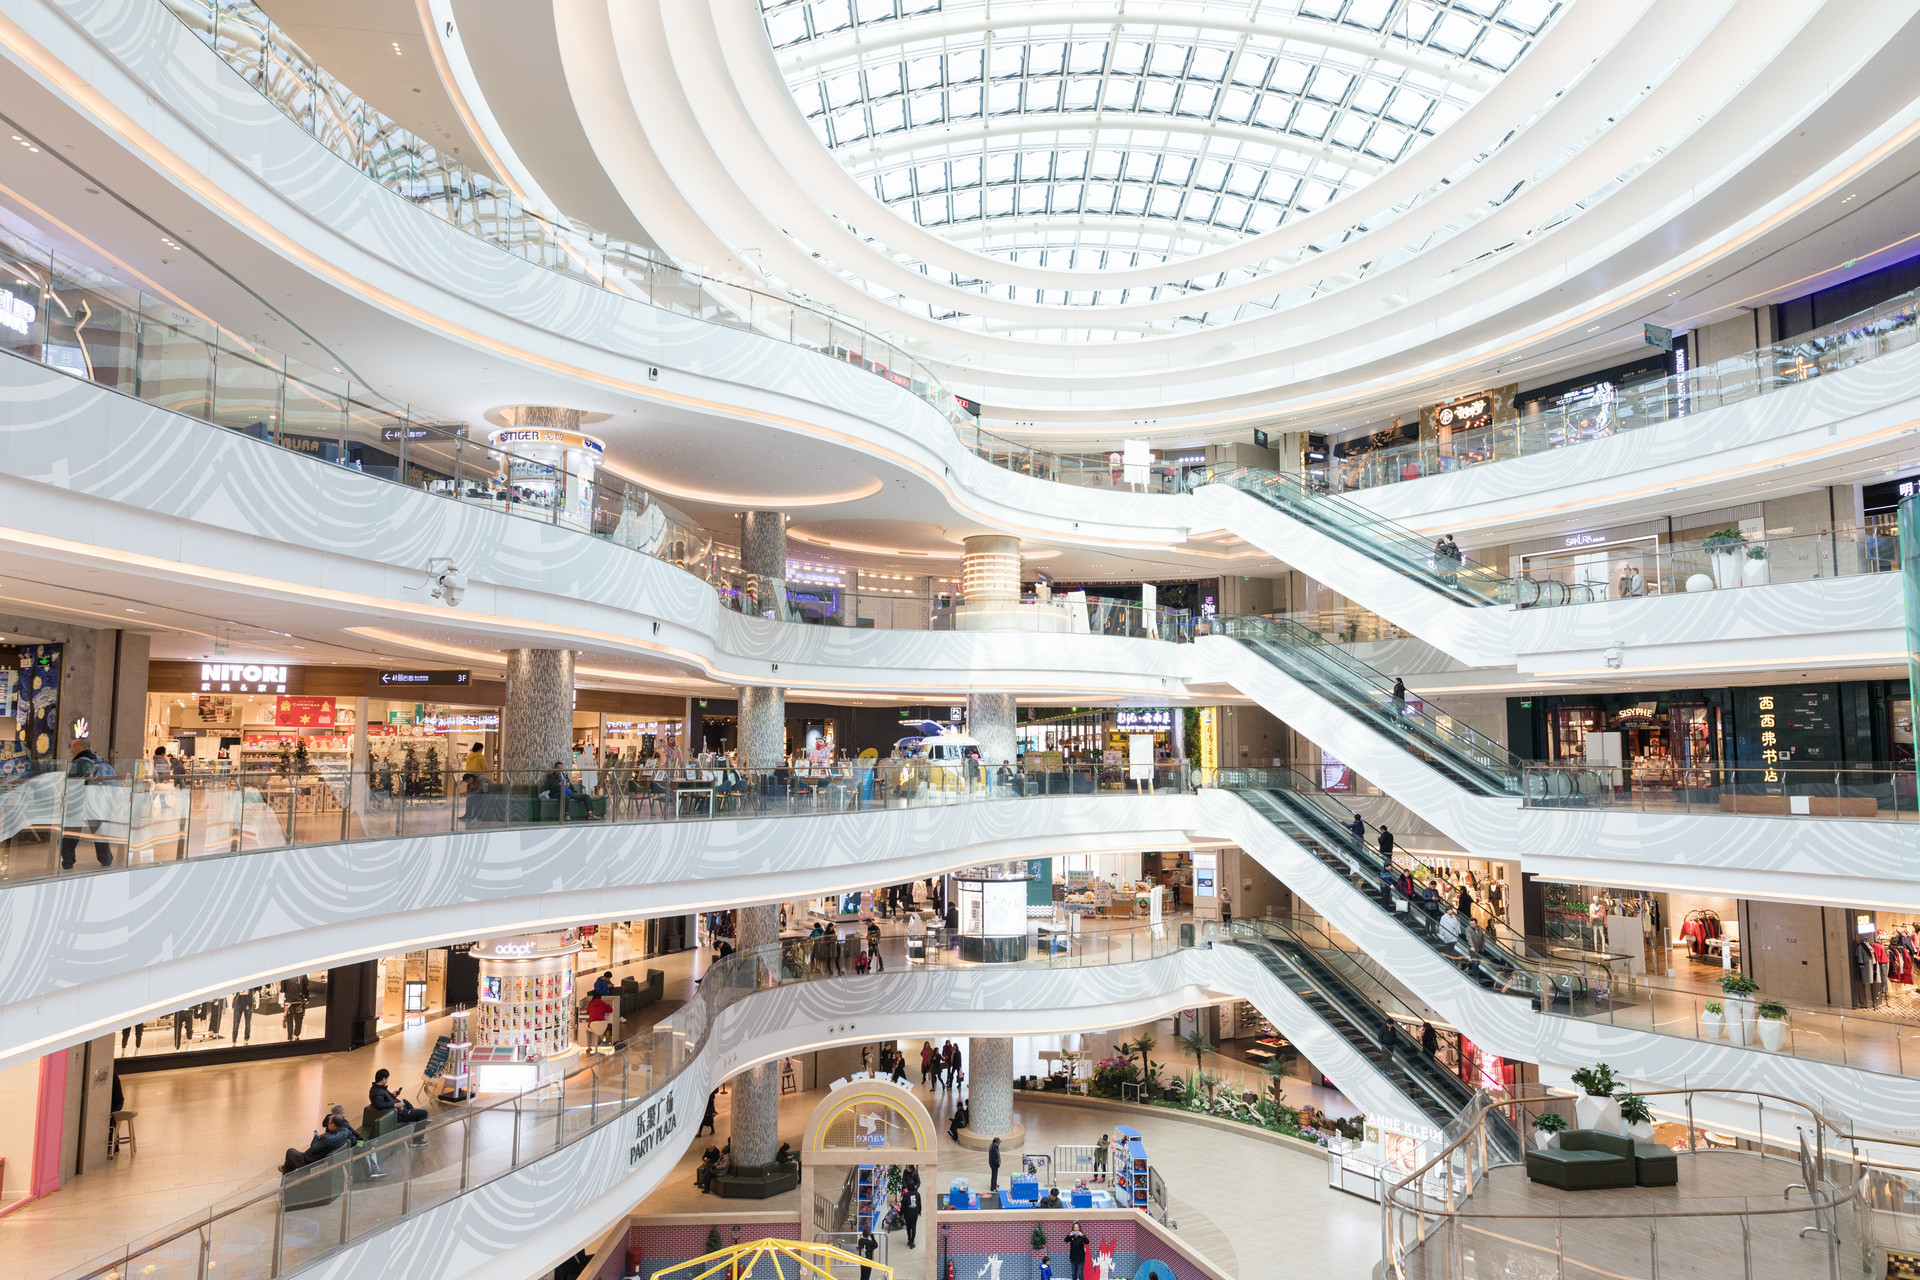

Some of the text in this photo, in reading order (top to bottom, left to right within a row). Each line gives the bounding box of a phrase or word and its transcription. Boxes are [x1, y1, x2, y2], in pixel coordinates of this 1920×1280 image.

[508, 431, 540, 440] TIGER
[1566, 534, 1593, 546] SAKURA
[201, 664, 287, 683] NITORI
[458, 674, 467, 682] 3F
[1618, 708, 1653, 718] SISYPHE
[1758, 696, 1778, 782] 西西弗书店
[1561, 975, 1569, 987] 2
[636, 1089, 674, 1139] 乐聚广场
[1368, 1112, 1443, 1142] ANNE KLEIN
[630, 1113, 677, 1165] PARTY PLAZA
